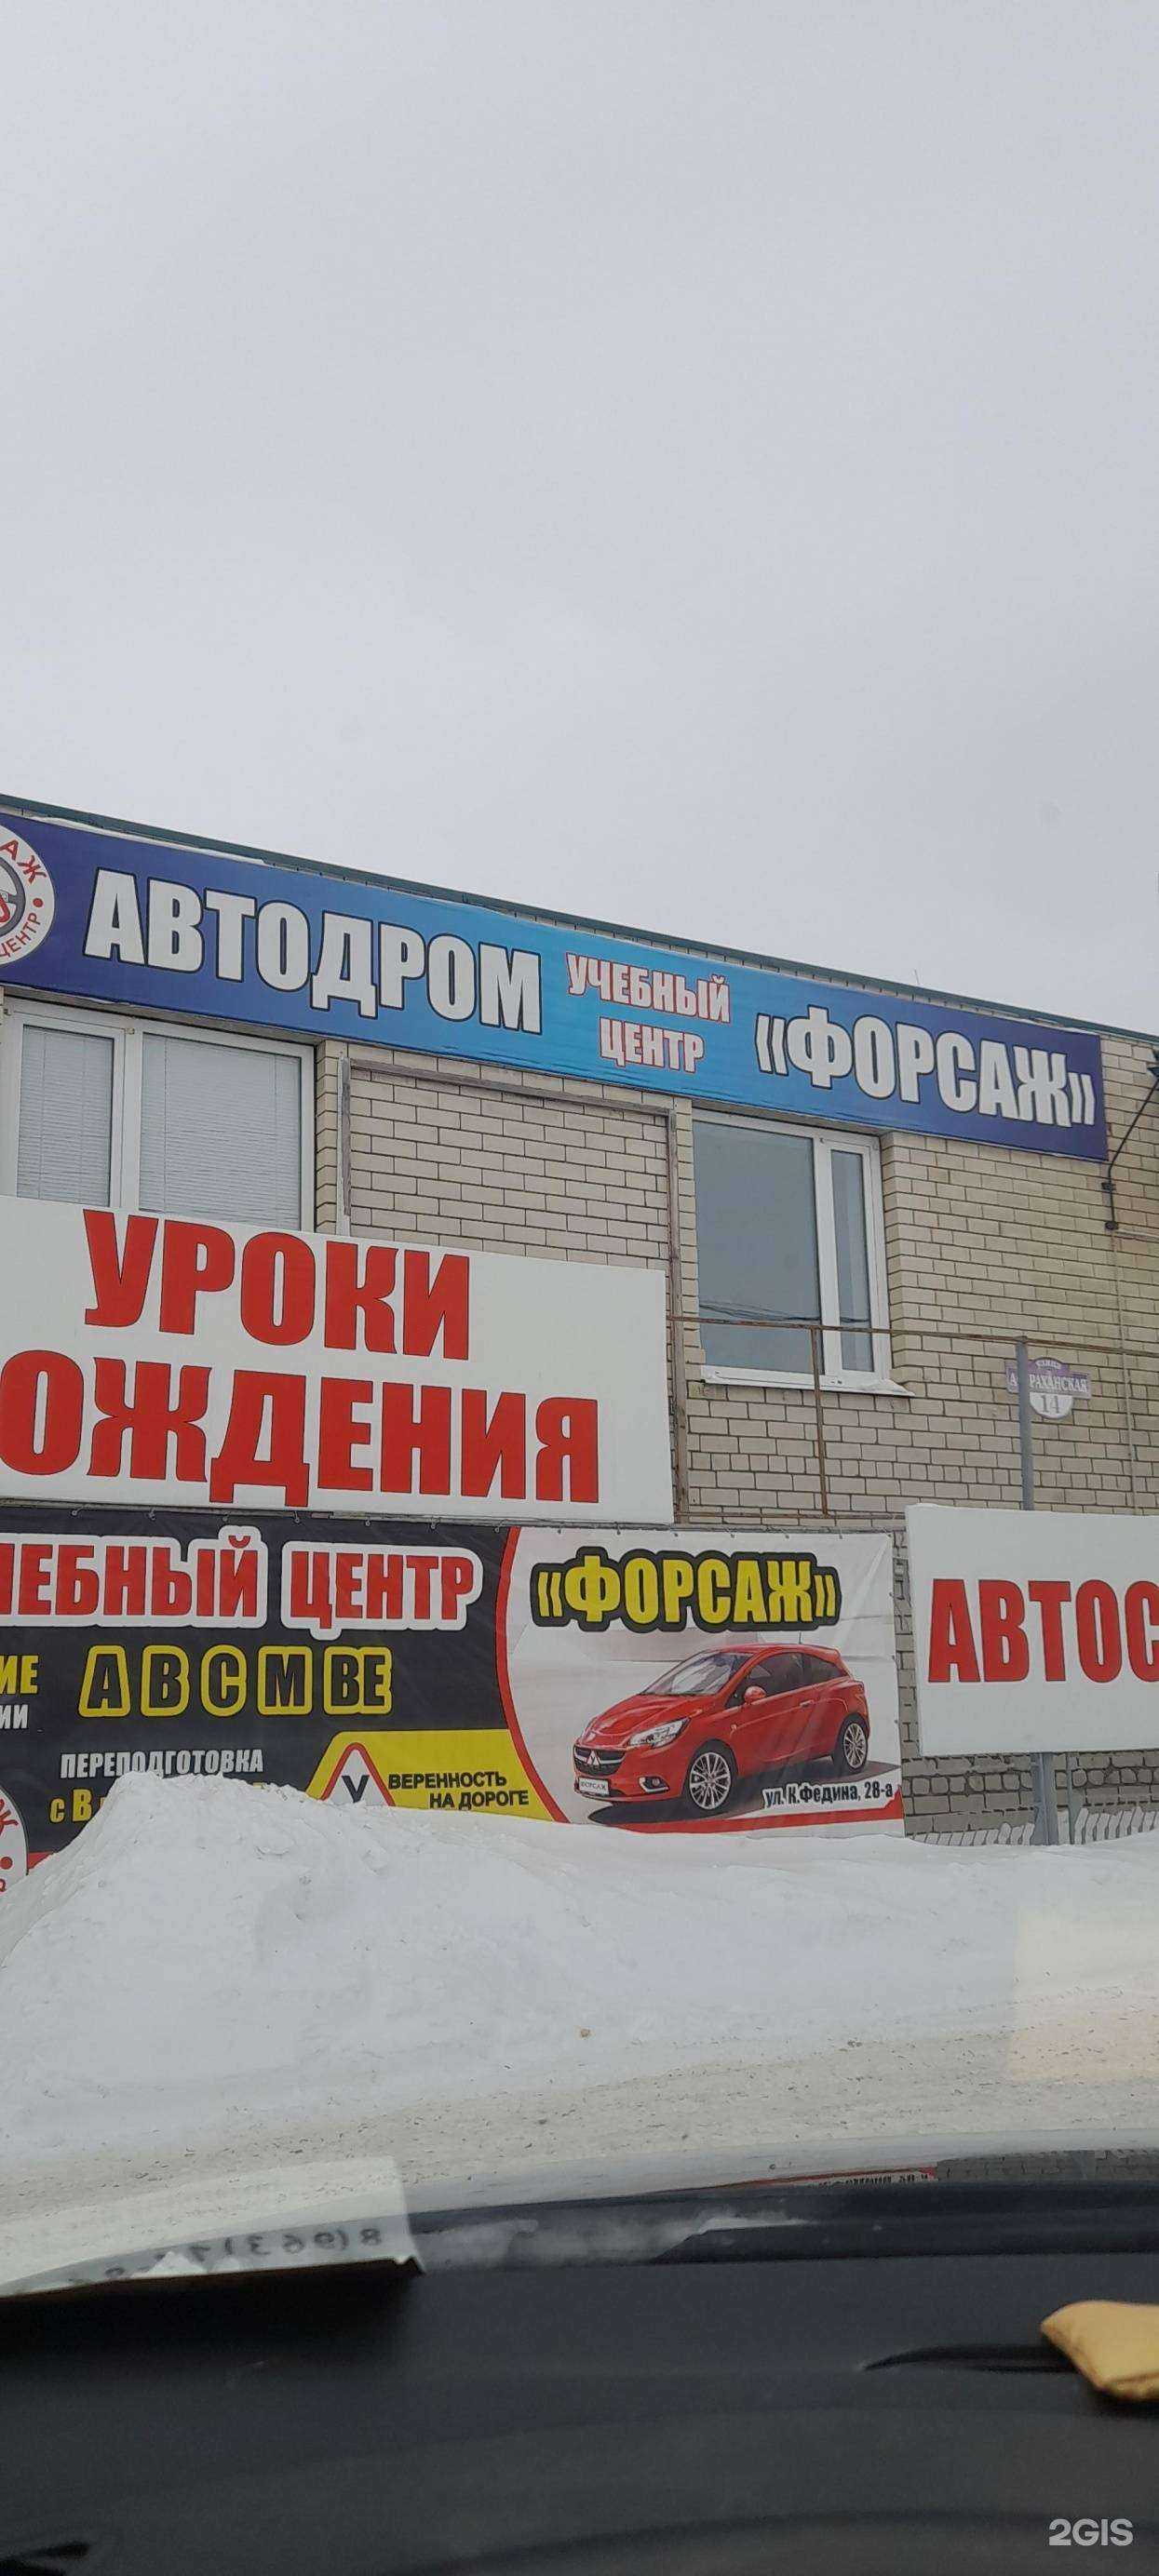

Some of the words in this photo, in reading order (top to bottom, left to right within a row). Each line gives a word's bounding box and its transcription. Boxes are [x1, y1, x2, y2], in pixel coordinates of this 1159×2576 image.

[84, 867, 542, 1035] АВТОДРОМ
[565, 952, 731, 1024] УЧЕБНЫЙ
[599, 1017, 705, 1073] ЦЕНТР
[754, 1004, 1096, 1128] «ФОРСАЖ»
[83, 1209, 469, 1360] УРОКИ
[1009, 1372, 1088, 1393] АРАХАНСКАЯ
[1041, 1394, 1059, 1414] 14
[0, 1349, 599, 1507] ОЖДЕНИЯ
[290, 1550, 474, 1629] ЦЕНТР
[538, 1555, 836, 1623] «ФОРСАЖ»
[928, 1578, 1159, 1683] АВТОС
[60, 1749, 263, 1778] ПЕРЕПОДГОТОВКА
[388, 1771, 507, 1790] ВЕРЕННОСТЬ
[765, 1790, 785, 1807] ул.
[864, 1780, 894, 1800] 28-а
[429, 1792, 457, 1808] НА
[458, 1790, 529, 1810] ДОРОГЕ
